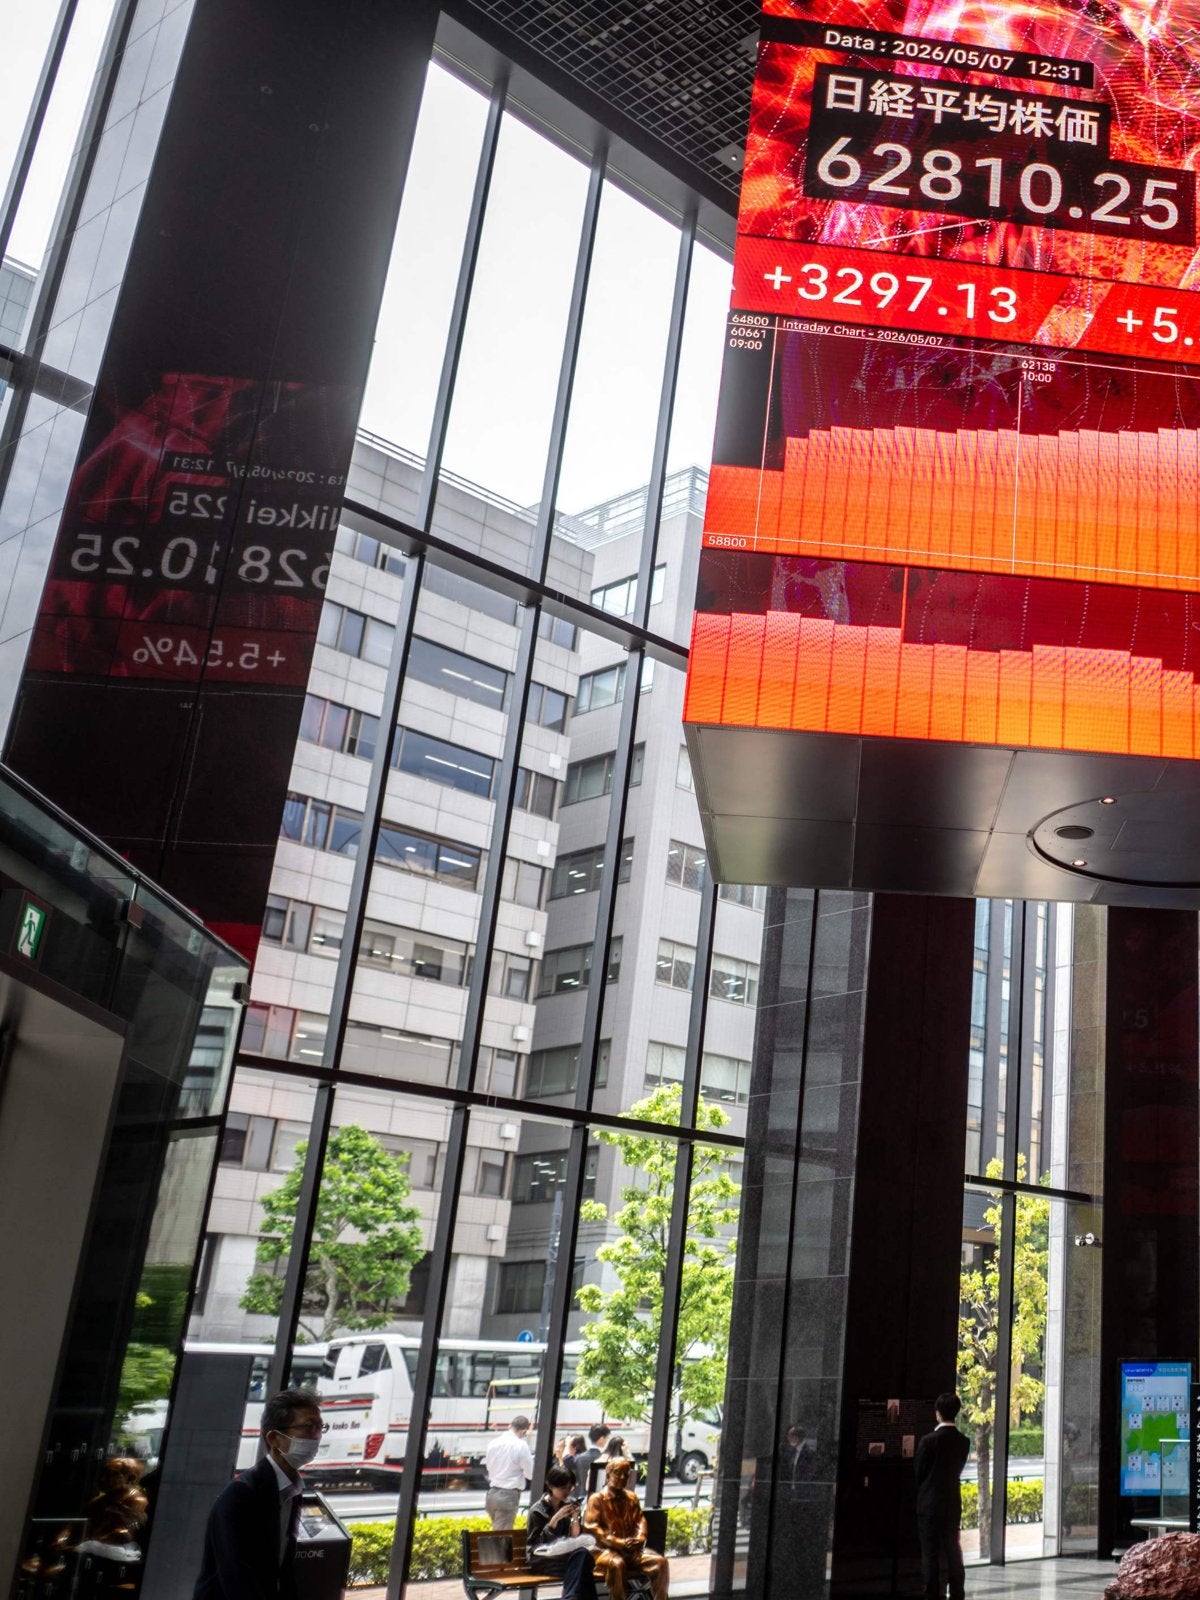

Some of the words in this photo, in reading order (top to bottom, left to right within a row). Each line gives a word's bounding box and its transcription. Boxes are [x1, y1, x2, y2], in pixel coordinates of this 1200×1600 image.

[825, 30, 877, 51] Data
[892, 39, 1014, 71] 2026/05/07
[1027, 59, 1082, 81] 12:31
[825, 75, 1100, 146] 日経平均株価
[816, 137, 1179, 230] 62810.25
[763, 263, 1018, 323] +3297.13
[732, 314, 769, 326] 64800
[730, 328, 767, 339] 60661
[782, 320, 831, 334] Intraday
[834, 325, 866, 337] Chart
[877, 330, 943, 346] 2026/05/07
[729, 339, 762, 350] 09:00
[1021, 360, 1056, 372] 62138
[1022, 371, 1052, 383] 10:00
[708, 536, 747, 548] 58800
